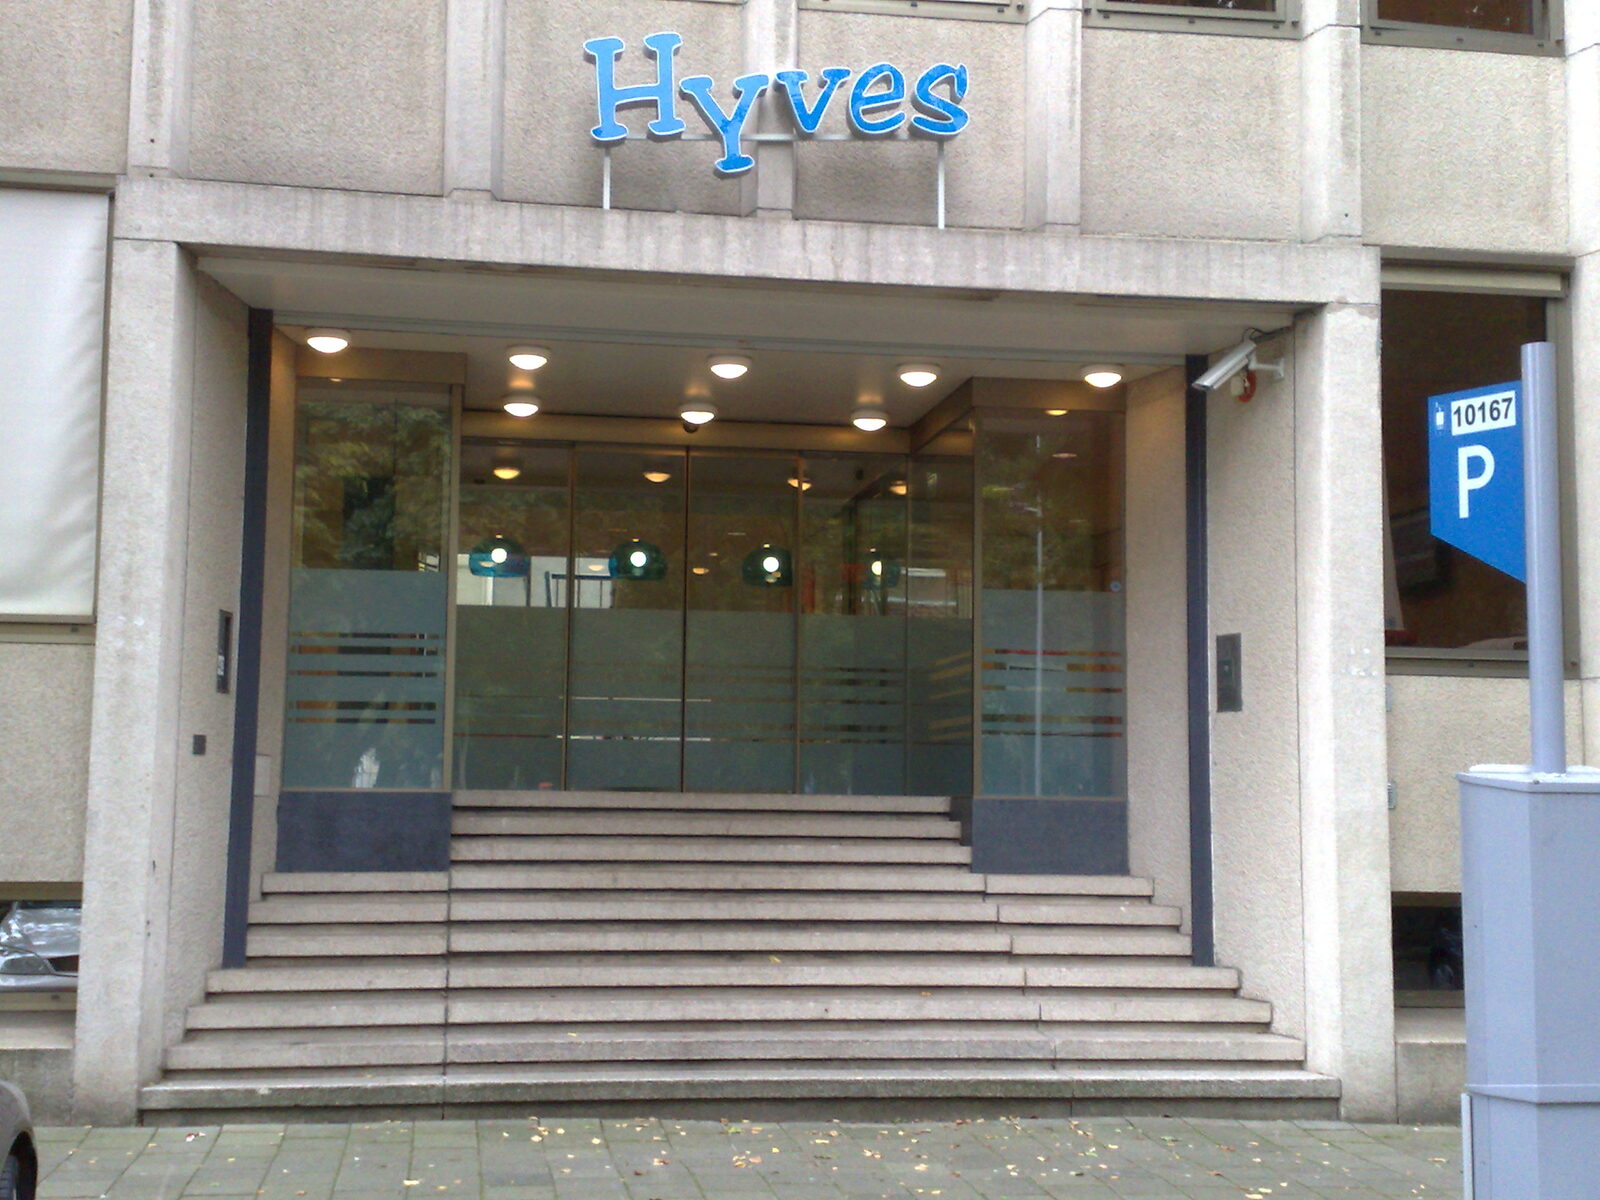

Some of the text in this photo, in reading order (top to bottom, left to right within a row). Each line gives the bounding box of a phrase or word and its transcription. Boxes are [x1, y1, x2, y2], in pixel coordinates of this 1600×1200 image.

[583, 31, 969, 174] Hyves
[1452, 397, 1514, 428] 10167
[1457, 444, 1495, 519] P
